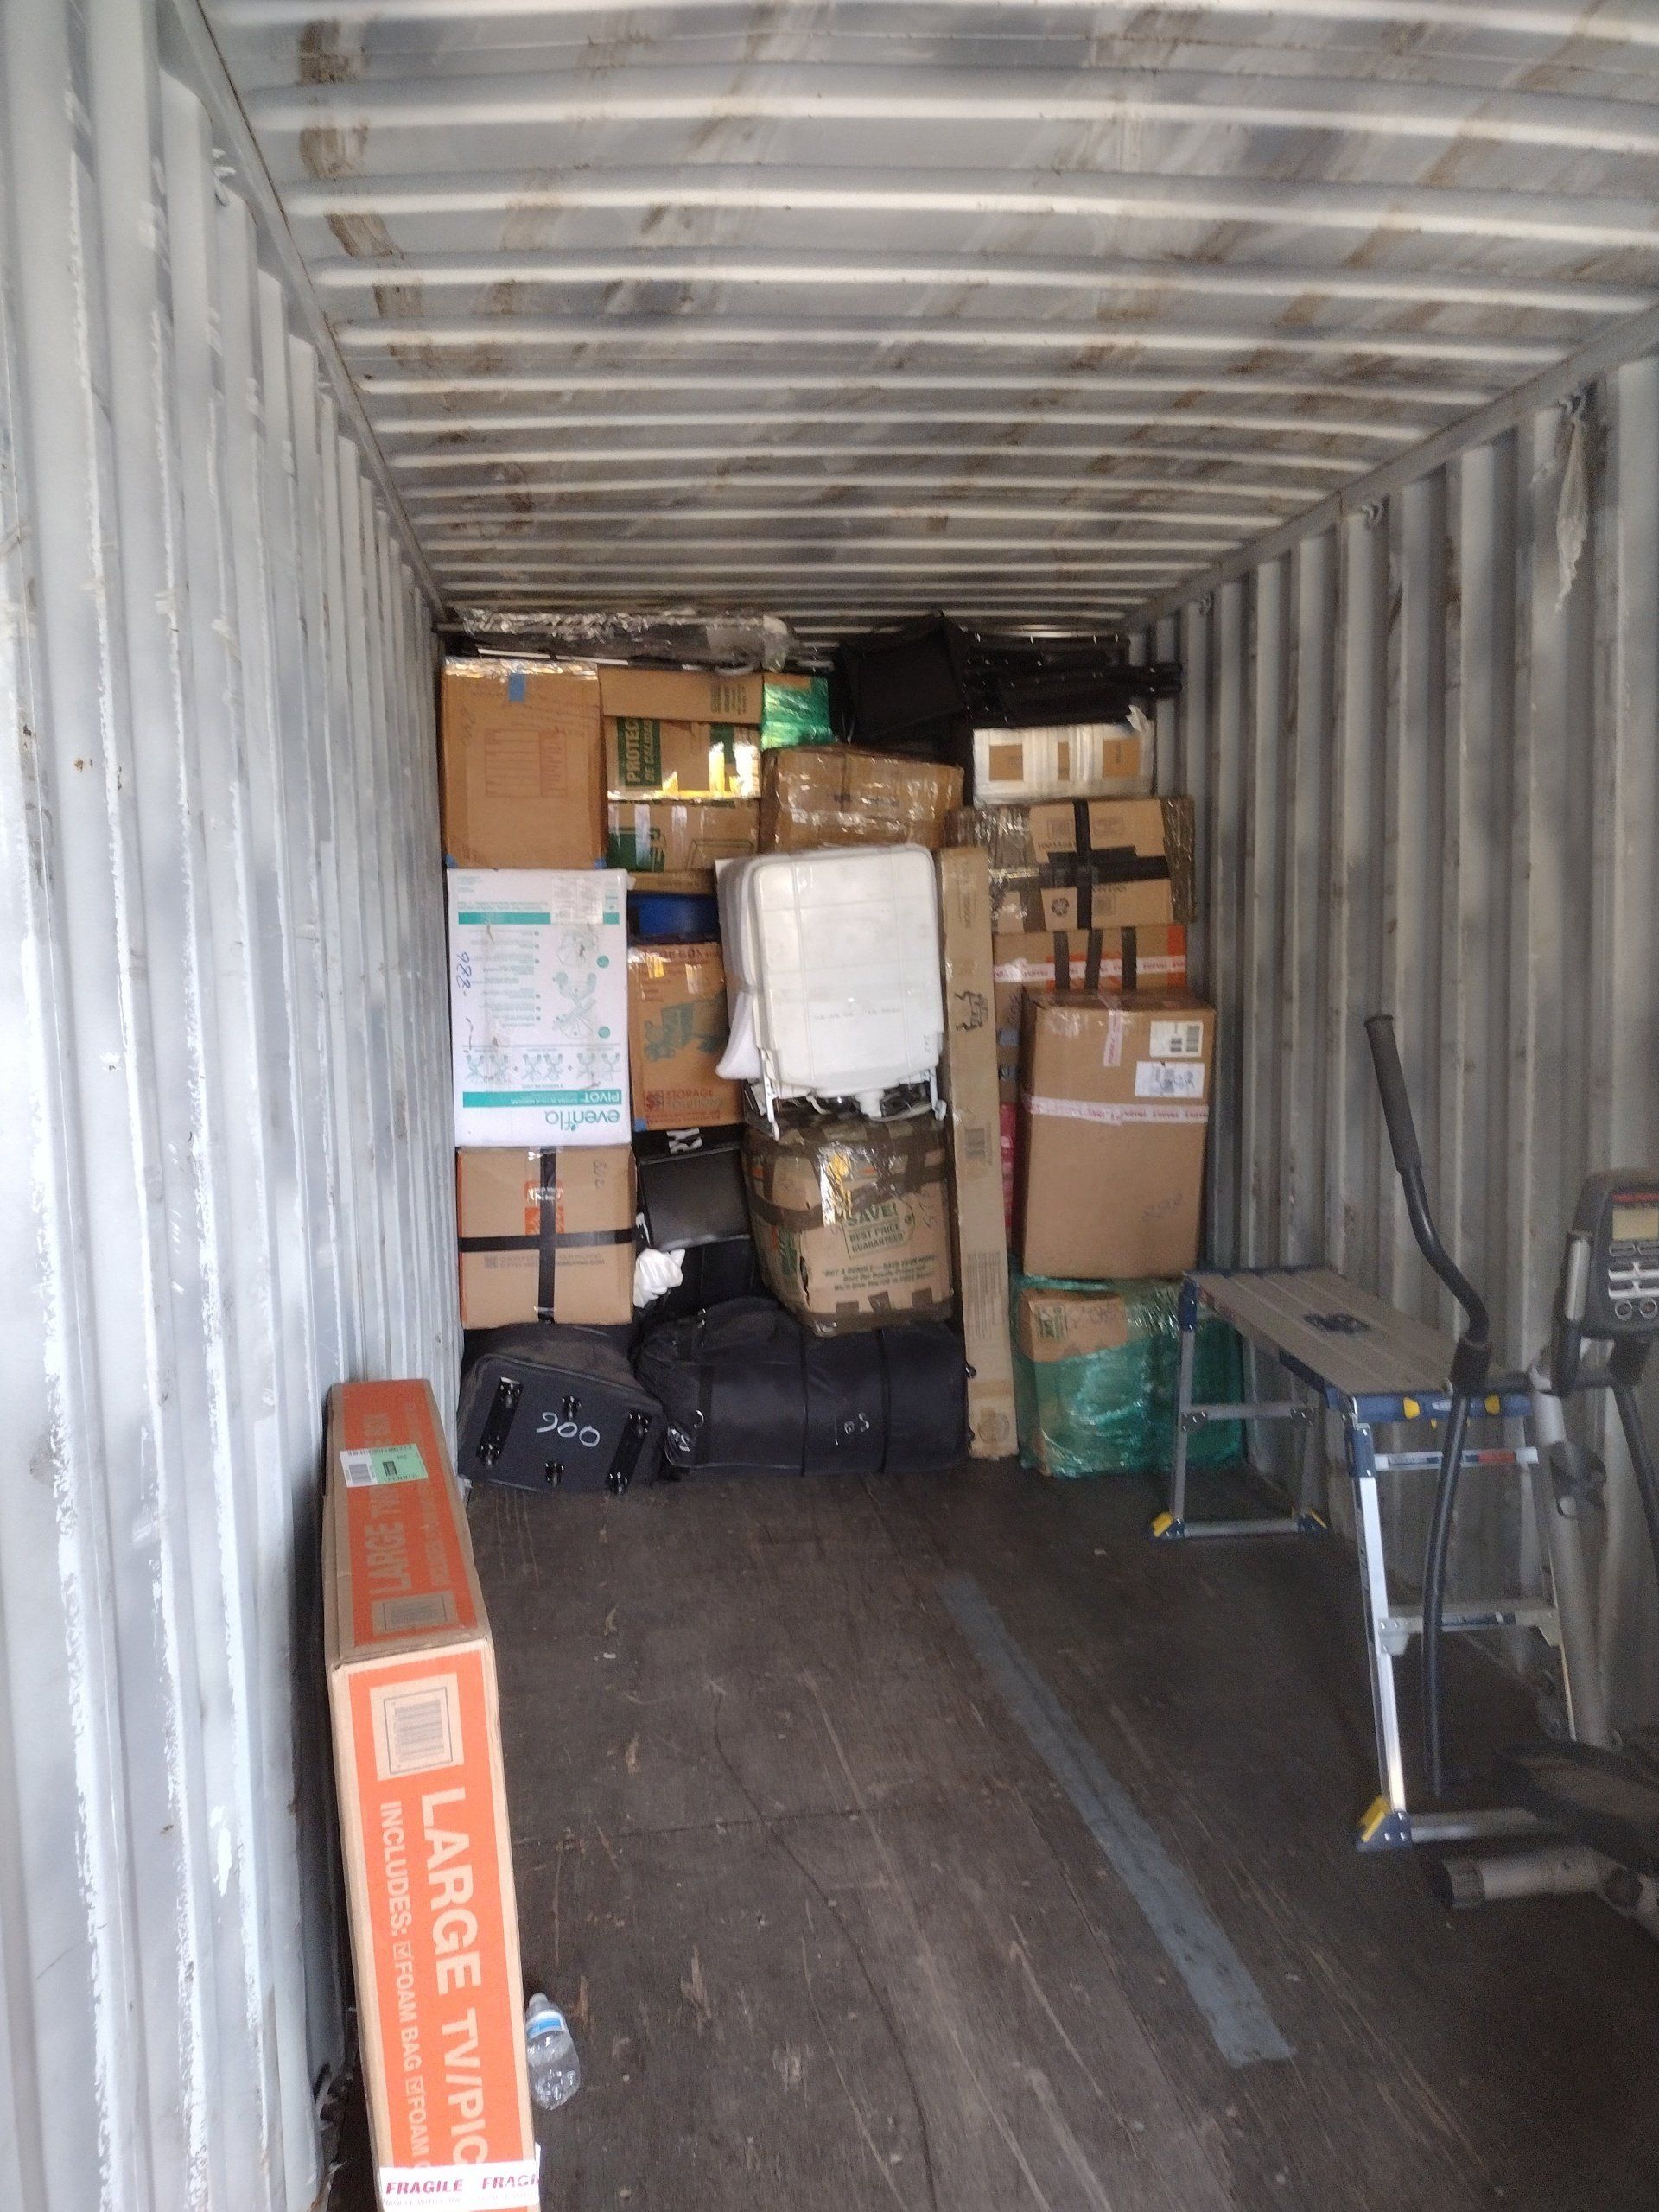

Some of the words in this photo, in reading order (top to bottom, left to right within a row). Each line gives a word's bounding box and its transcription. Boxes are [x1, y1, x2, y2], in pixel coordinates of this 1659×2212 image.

[583, 1091, 620, 1103] PIVOT
[846, 1204, 899, 1226] SAVE!
[849, 1230, 874, 1242] BEST
[874, 1224, 900, 1236] PRICE
[365, 1521, 410, 1595] LARGE
[380, 1800, 412, 1936] INCLUDES:
[421, 1786, 482, 1996] LARGE
[394, 1961, 417, 2023] FOAM
[400, 2026, 423, 2072] BAG
[407, 2096, 430, 2157] FOAM
[386, 2179, 464, 2195] FRAGILE
